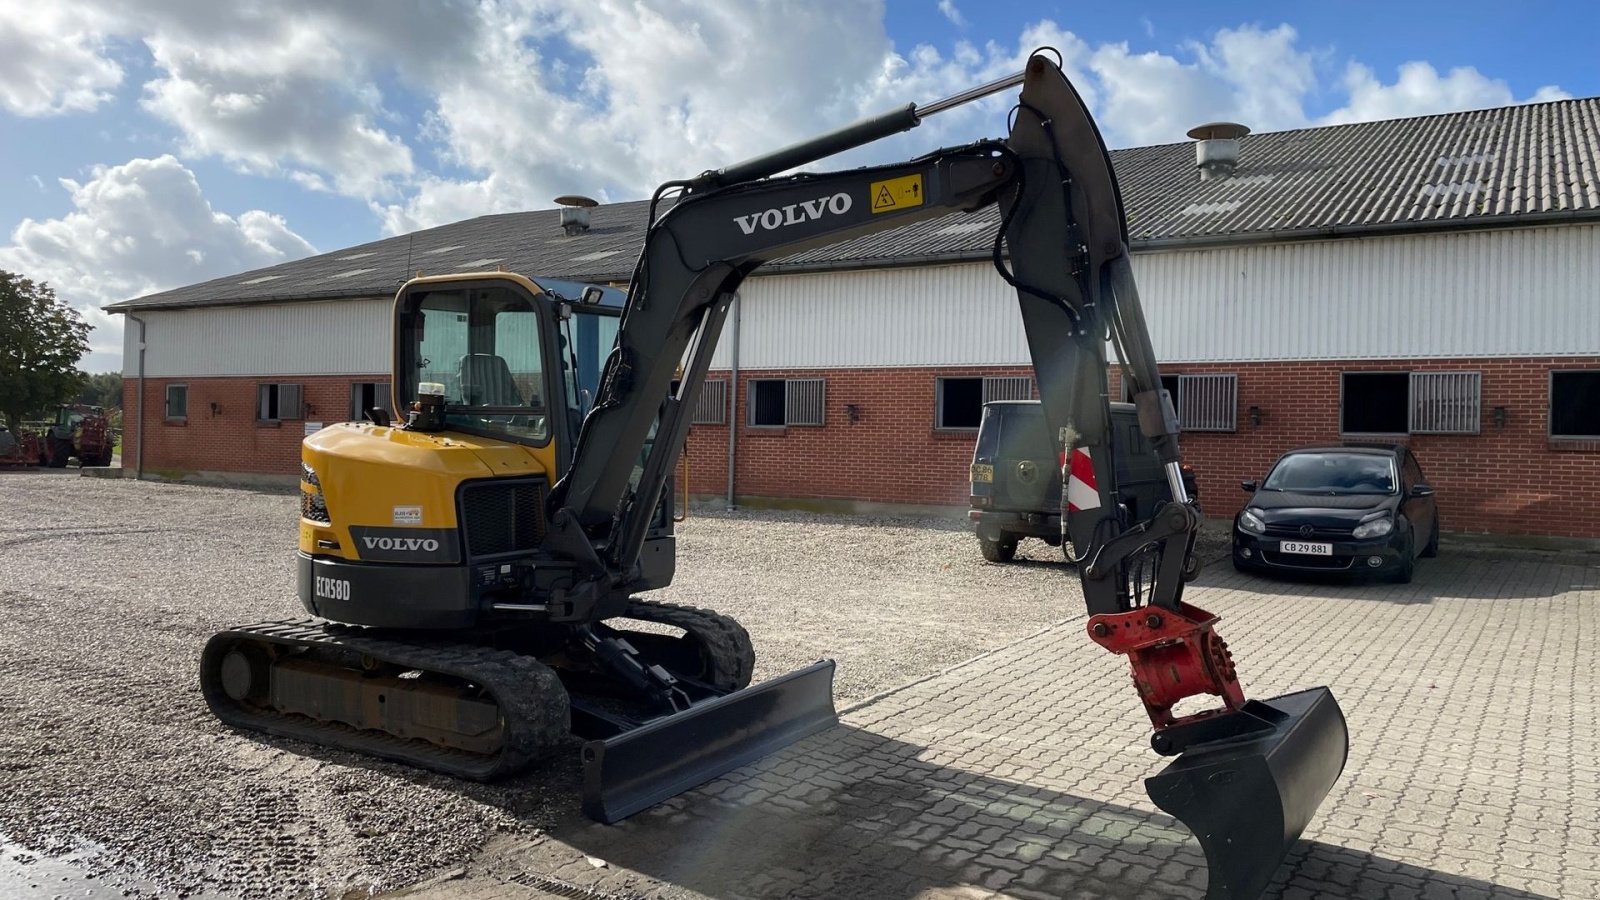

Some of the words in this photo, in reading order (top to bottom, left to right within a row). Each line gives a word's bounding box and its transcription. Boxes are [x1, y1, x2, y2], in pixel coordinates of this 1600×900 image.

[733, 192, 853, 235] VOLVO
[362, 536, 439, 552] VOLVO
[1284, 543, 1296, 552] CB
[1298, 544, 1310, 553] 29
[1311, 545, 1327, 554] 881
[316, 576, 350, 601] ECR58D
